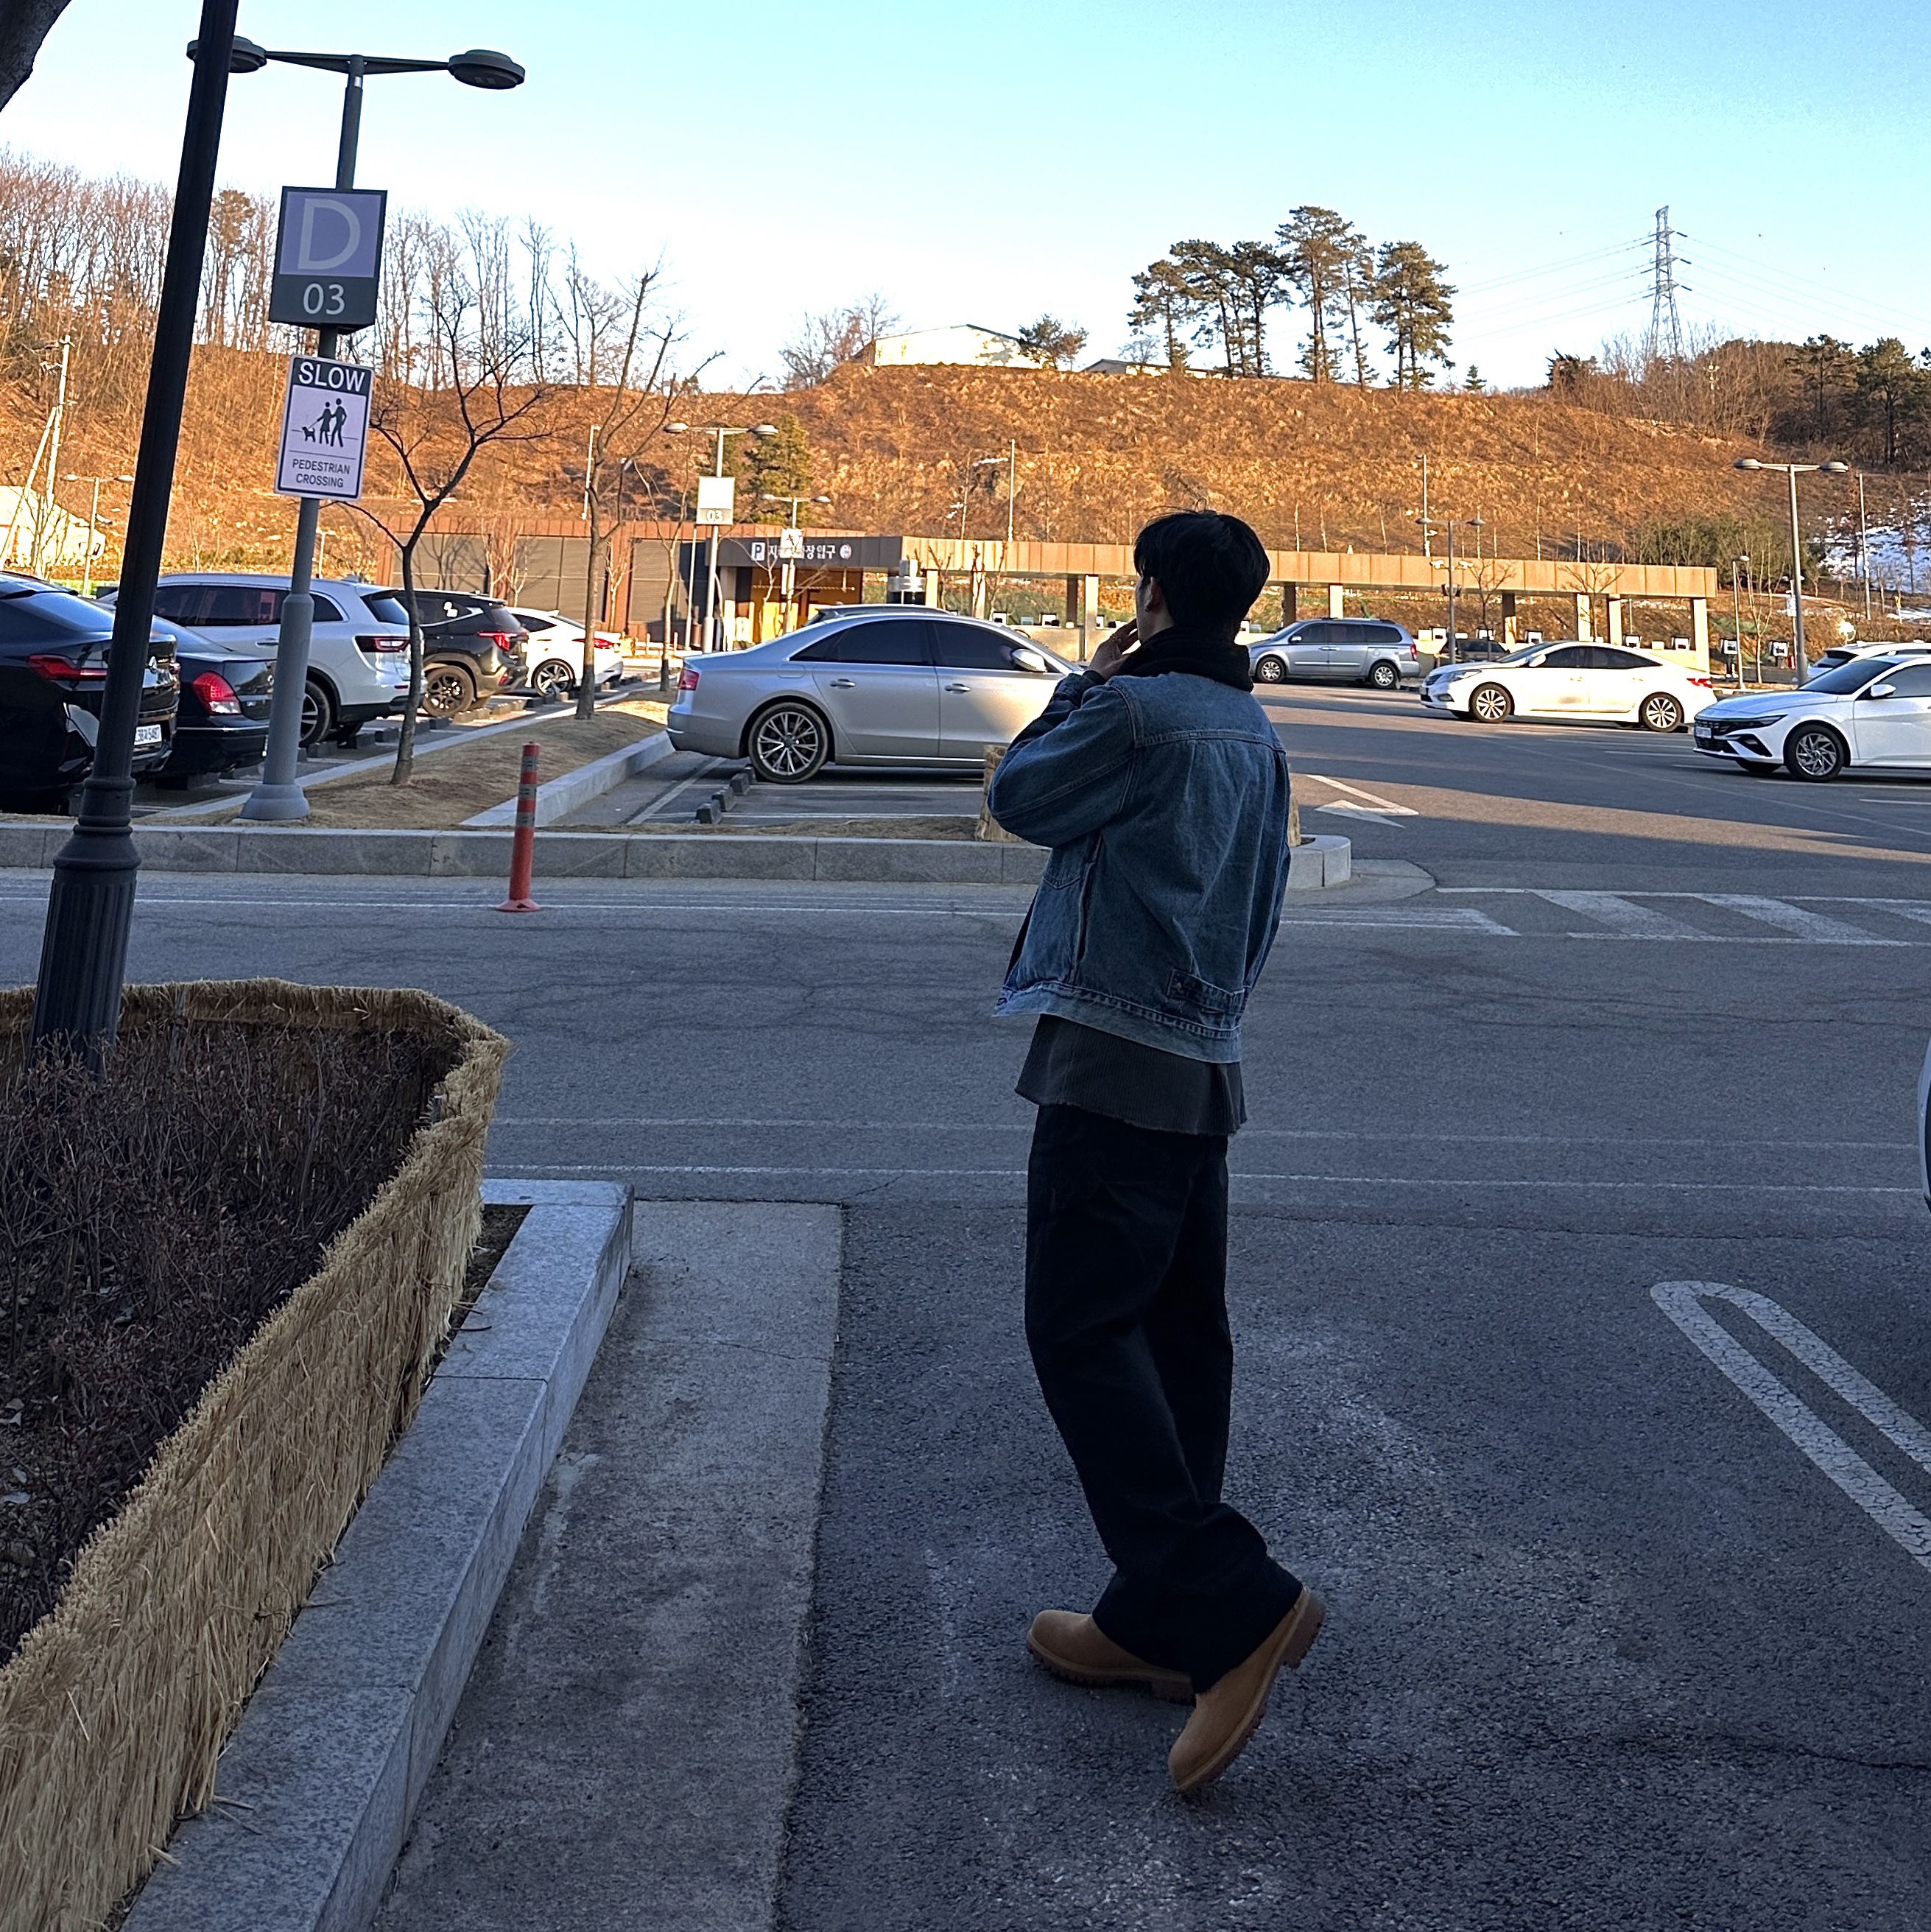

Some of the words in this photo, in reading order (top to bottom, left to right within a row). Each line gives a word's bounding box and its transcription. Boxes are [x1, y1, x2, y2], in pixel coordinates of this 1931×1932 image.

[298, 198, 361, 270] D
[303, 283, 345, 315] 03
[298, 361, 365, 392] SLOW
[292, 458, 351, 475] PEDESTRIAN
[296, 473, 344, 488] CROSSING
[707, 509, 723, 523] 03
